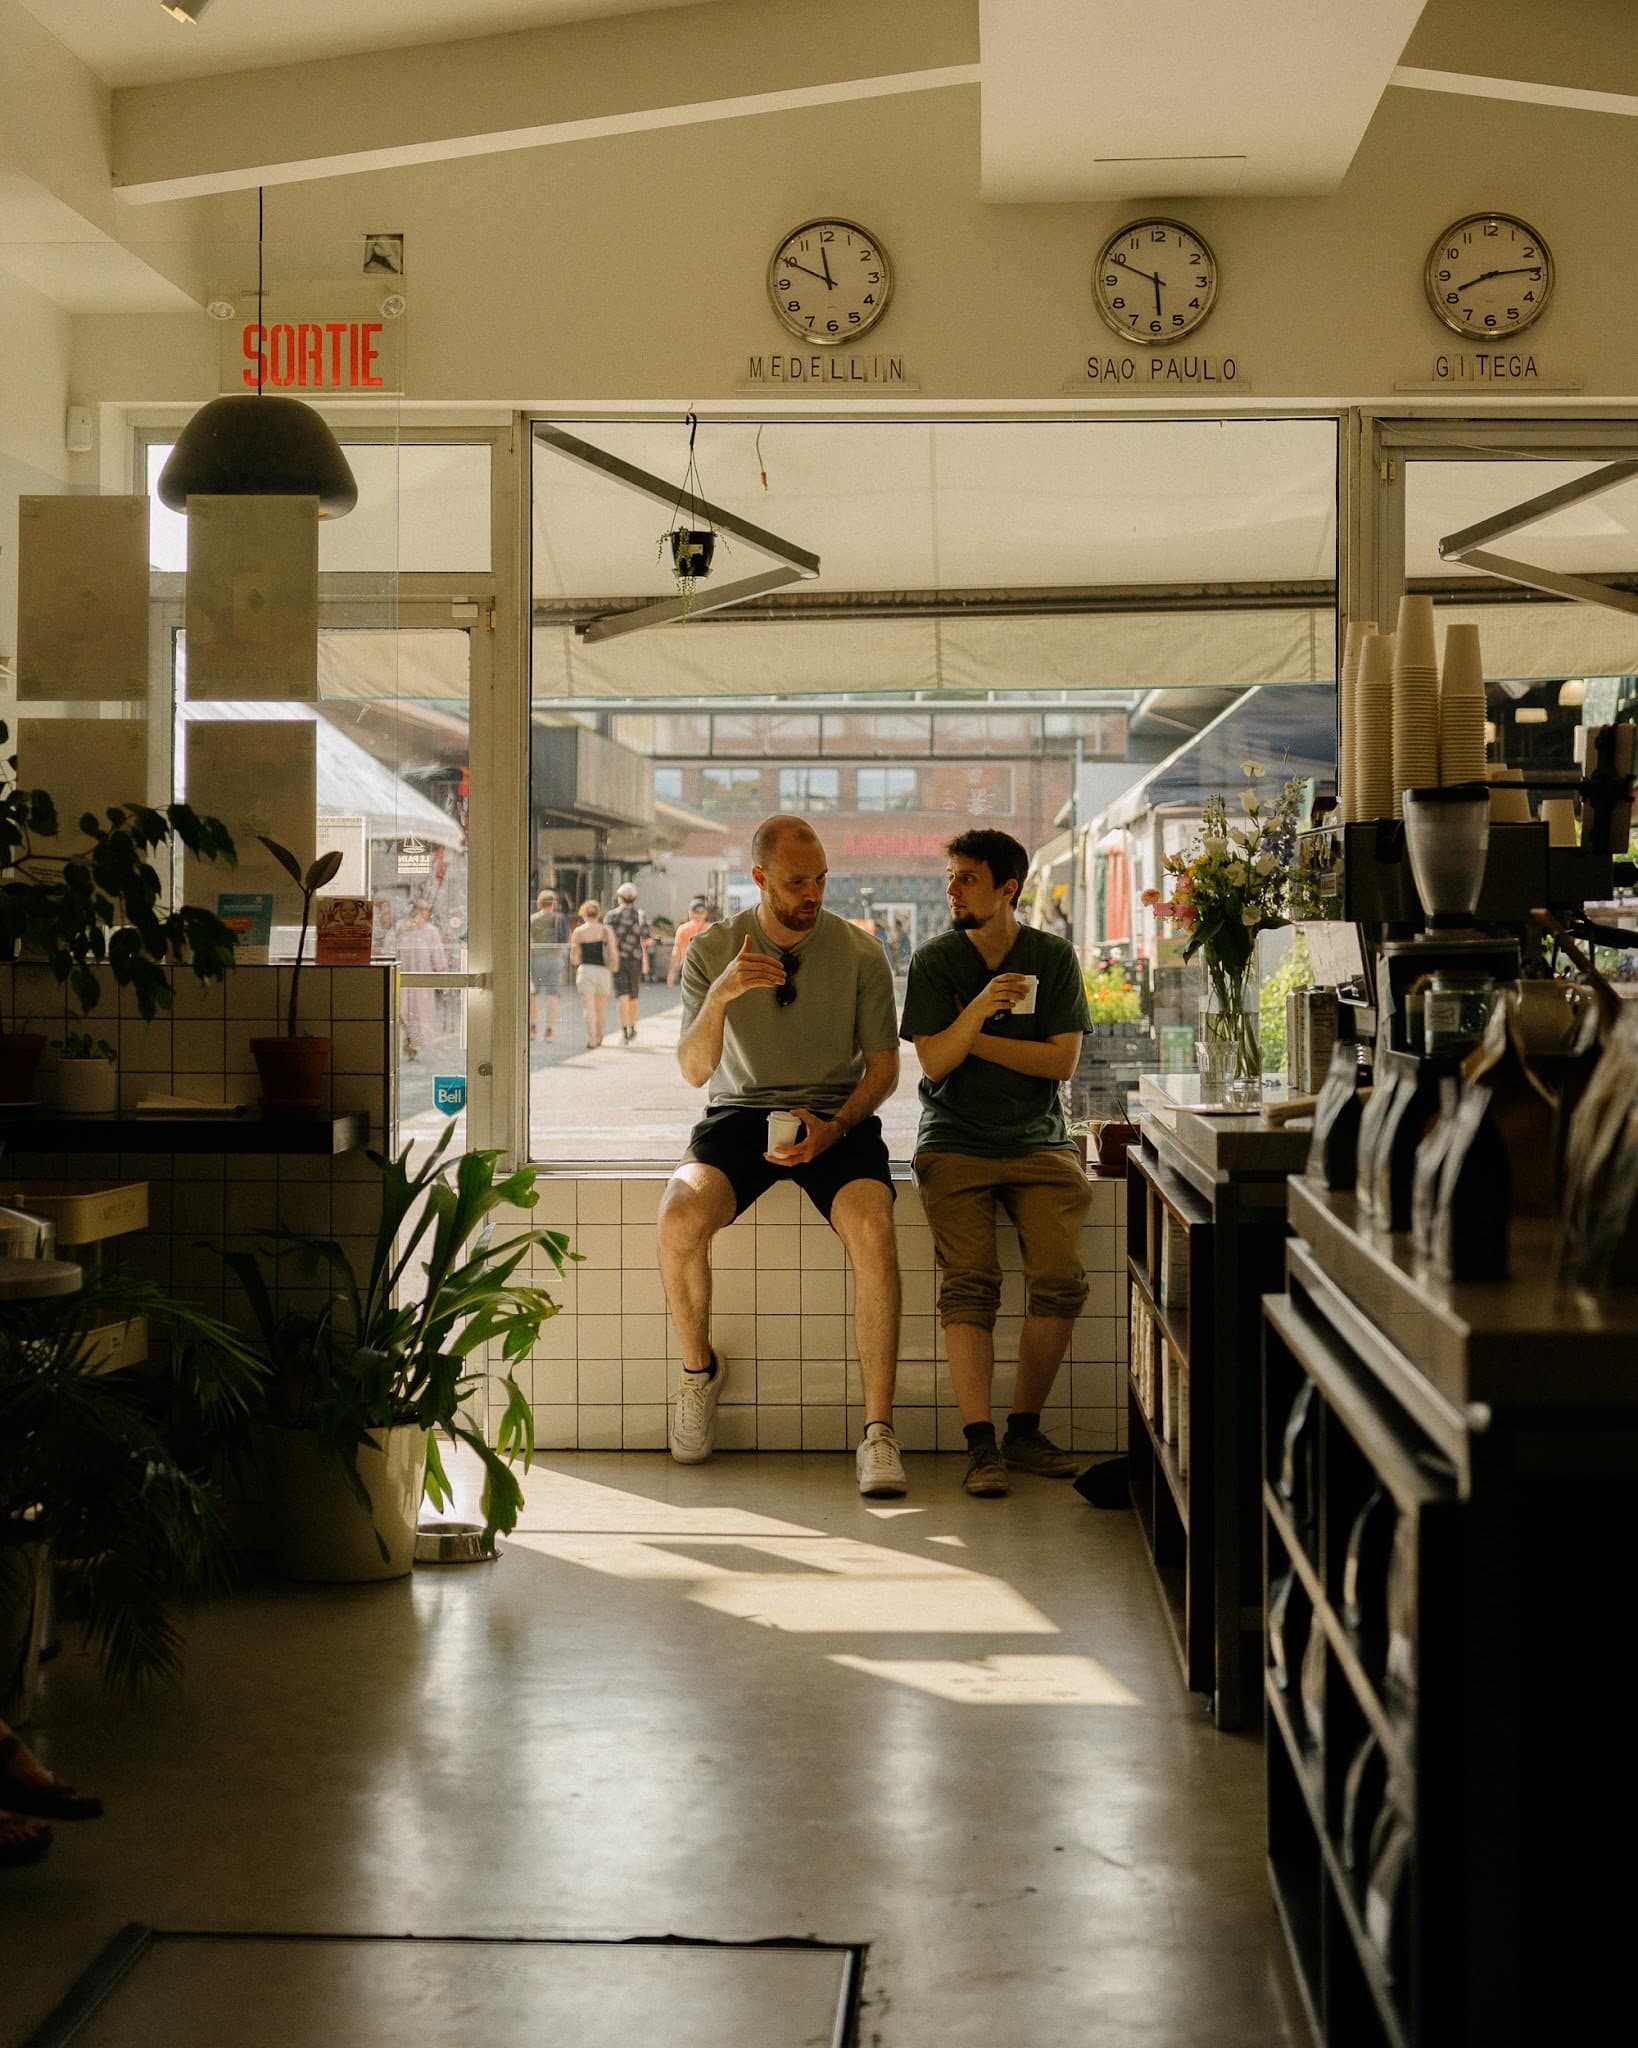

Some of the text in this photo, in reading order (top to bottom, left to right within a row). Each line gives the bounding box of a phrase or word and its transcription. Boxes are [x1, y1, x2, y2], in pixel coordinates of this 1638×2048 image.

[1484, 225, 1498, 236] 12
[820, 231, 835, 243] 12
[1151, 231, 1166, 243] 12
[1464, 232, 1471, 244] 11
[801, 240, 808, 251] 11
[1130, 238, 1139, 249] 11
[860, 251, 871, 261] 2
[1447, 248, 1459, 259] 10
[1523, 248, 1535, 258] 2
[785, 257, 797, 268] 10
[1114, 253, 1126, 265] 10
[1189, 254, 1201, 265] 2
[868, 272, 880, 283] 3
[1439, 270, 1451, 281] 9
[1529, 267, 1541, 281] 3
[779, 279, 791, 290] 9
[1106, 275, 1118, 286] 9
[1195, 277, 1207, 287] 3
[864, 294, 874, 305] 4
[1446, 293, 1459, 304] 8
[1523, 291, 1534, 302] 4
[788, 301, 800, 312] 8
[1113, 298, 1125, 309] 8
[1189, 298, 1200, 309] 4
[849, 312, 860, 323] 5
[1463, 309, 1473, 321] 7
[1507, 308, 1519, 319] 5
[805, 316, 815, 328] 7
[827, 320, 839, 332] 6
[1129, 315, 1139, 326] 7
[1172, 315, 1184, 326] 5
[1484, 315, 1496, 326] 6
[1150, 321, 1161, 332] 6
[243, 323, 383, 387] SORTIE
[750, 356, 902, 380] MEDELLIN
[1088, 356, 1236, 380] SAO PAULO
[1436, 355, 1537, 377] GITEGA
[439, 1089, 461, 1103] Bell
